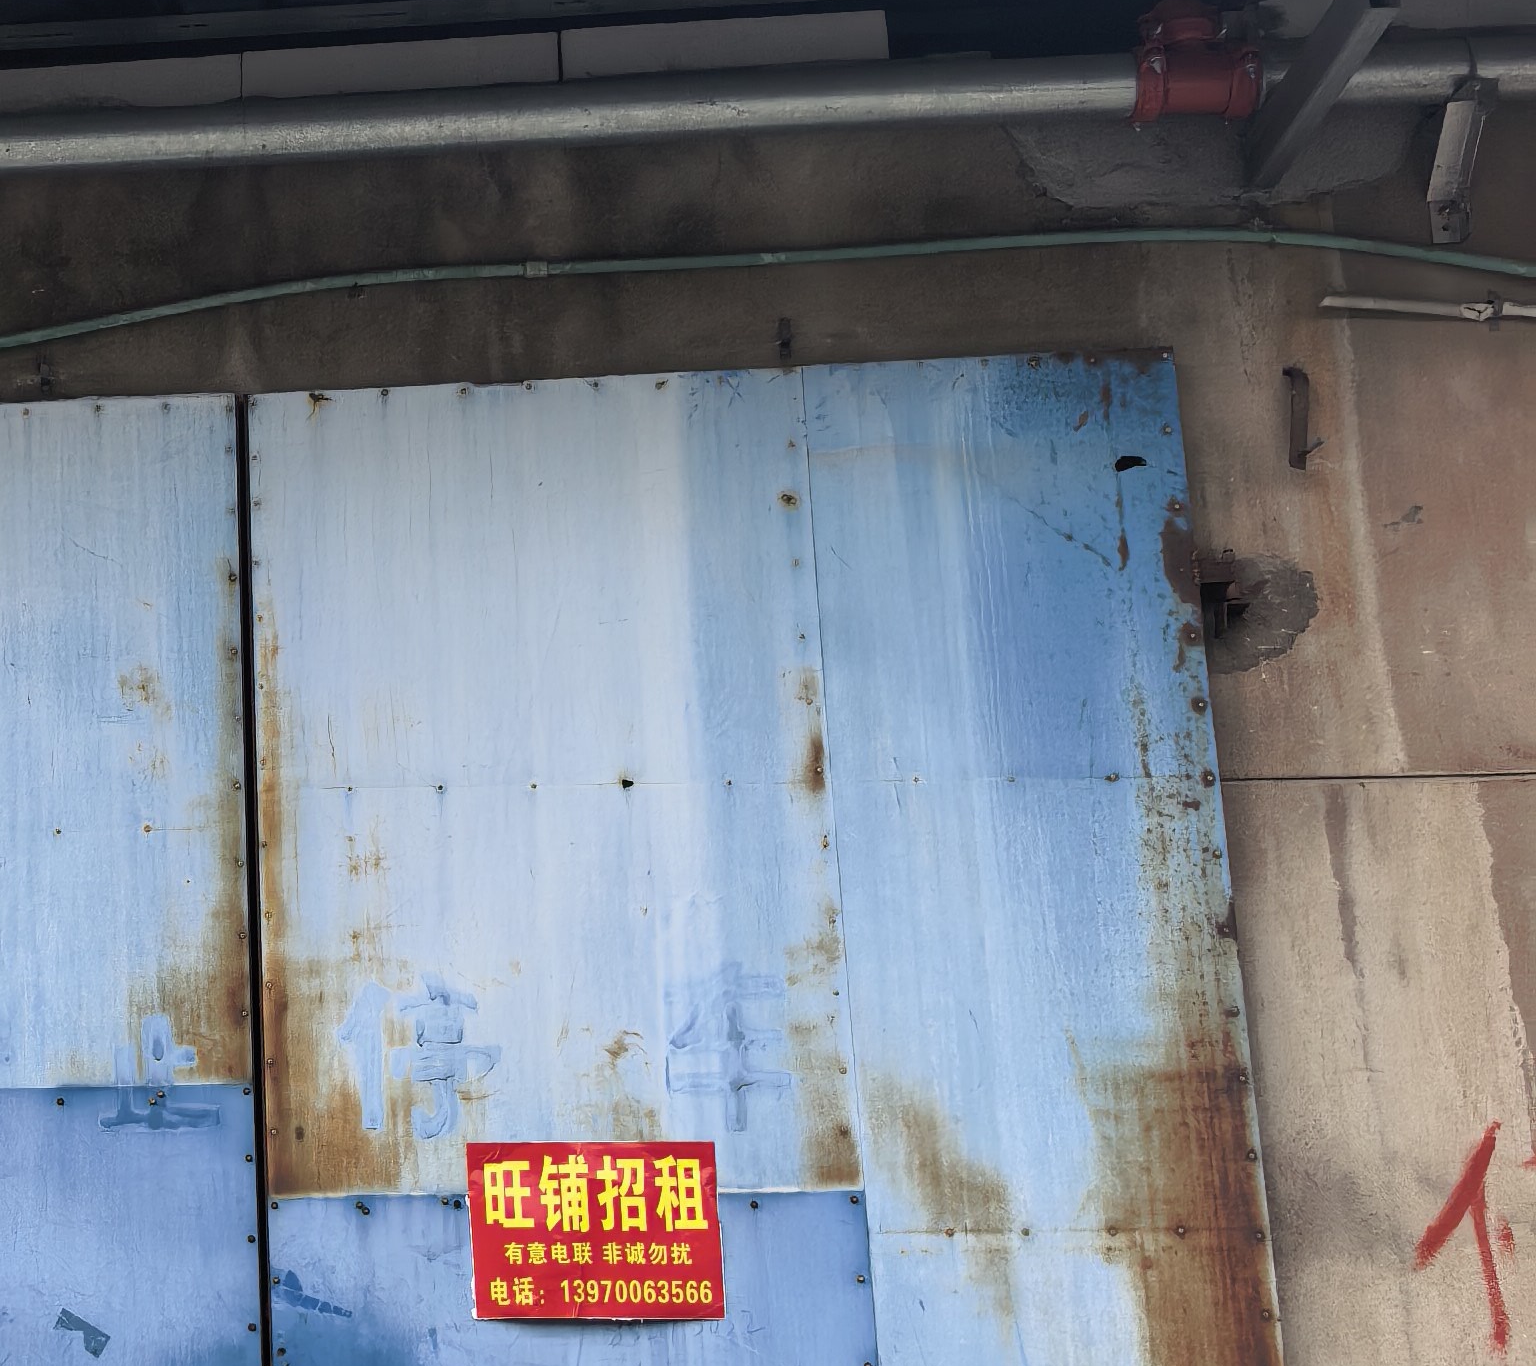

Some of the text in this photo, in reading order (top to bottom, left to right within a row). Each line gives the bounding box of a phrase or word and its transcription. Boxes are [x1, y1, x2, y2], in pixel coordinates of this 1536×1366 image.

[483, 1154, 709, 1233] 旺铺招租
[503, 1241, 693, 1265] 有意电联 非诚勿扰
[490, 1276, 713, 1306] 电话： 13970063566
